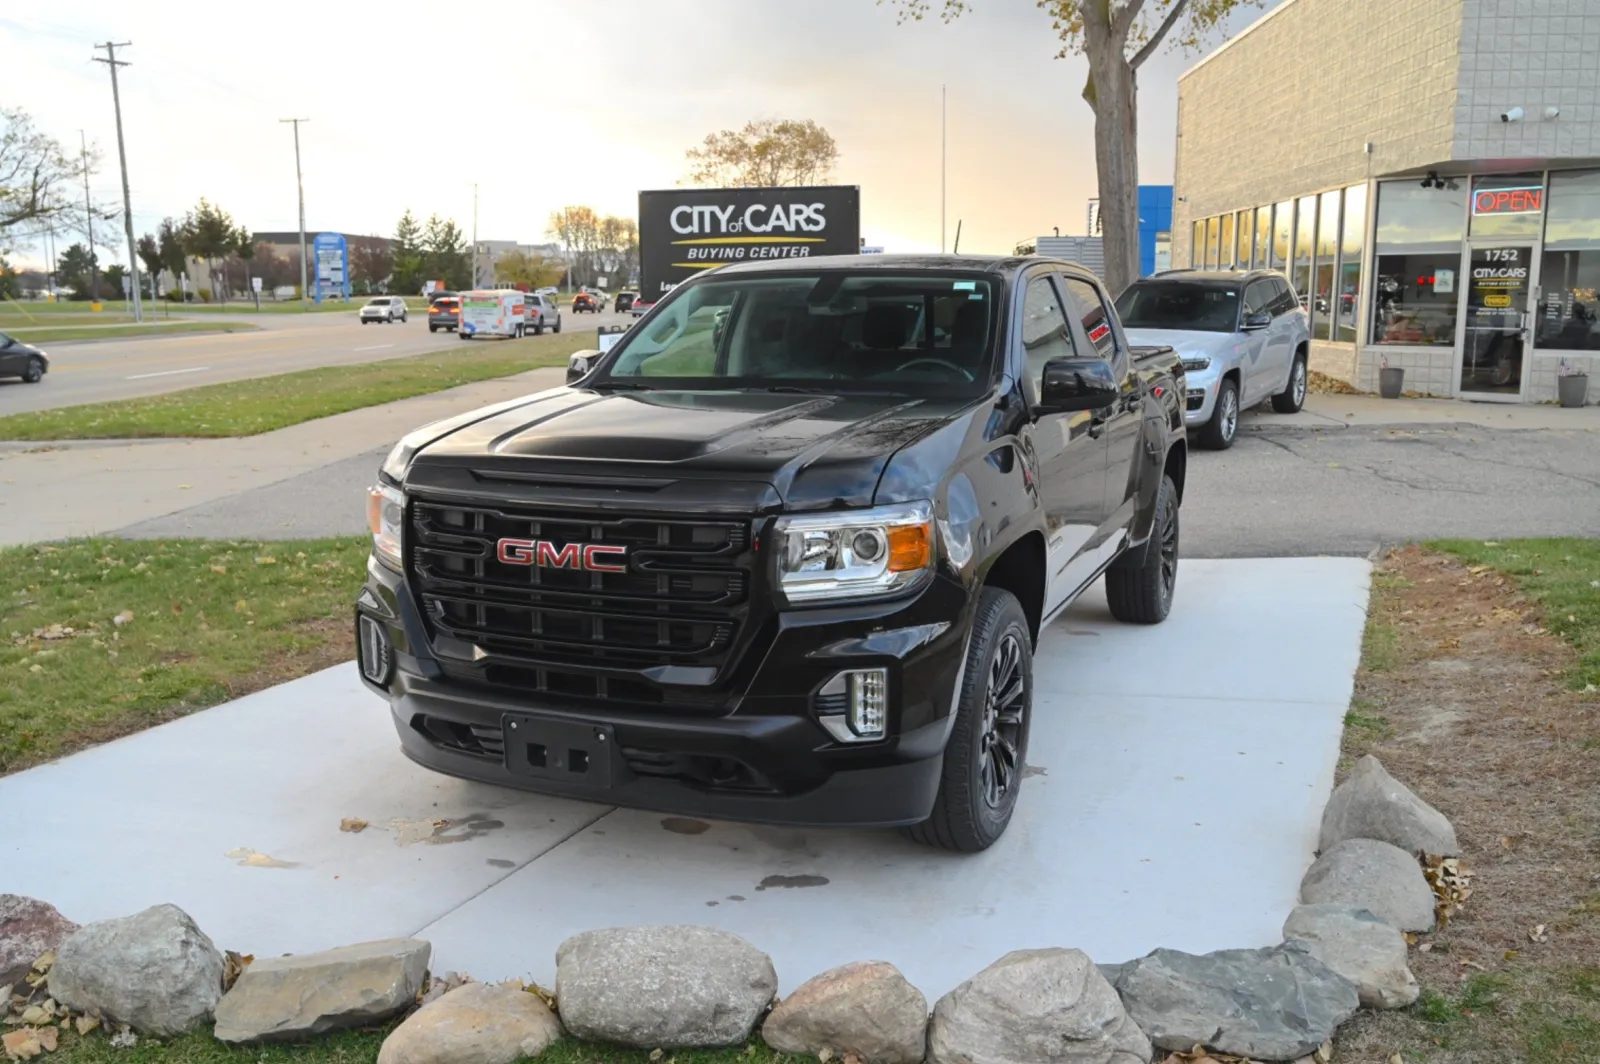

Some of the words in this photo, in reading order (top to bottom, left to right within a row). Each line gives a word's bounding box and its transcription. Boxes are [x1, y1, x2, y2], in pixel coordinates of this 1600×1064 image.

[1477, 190, 1542, 212] OPEN
[670, 204, 736, 234] CITY
[728, 216, 744, 233] of
[744, 203, 826, 233] CARS
[687, 248, 745, 259] BUYING
[749, 246, 810, 258] CENTER
[1484, 249, 1519, 261] 1752
[1473, 268, 1497, 278] CITY
[1498, 267, 1527, 278] CARS
[497, 537, 627, 574] GMC
